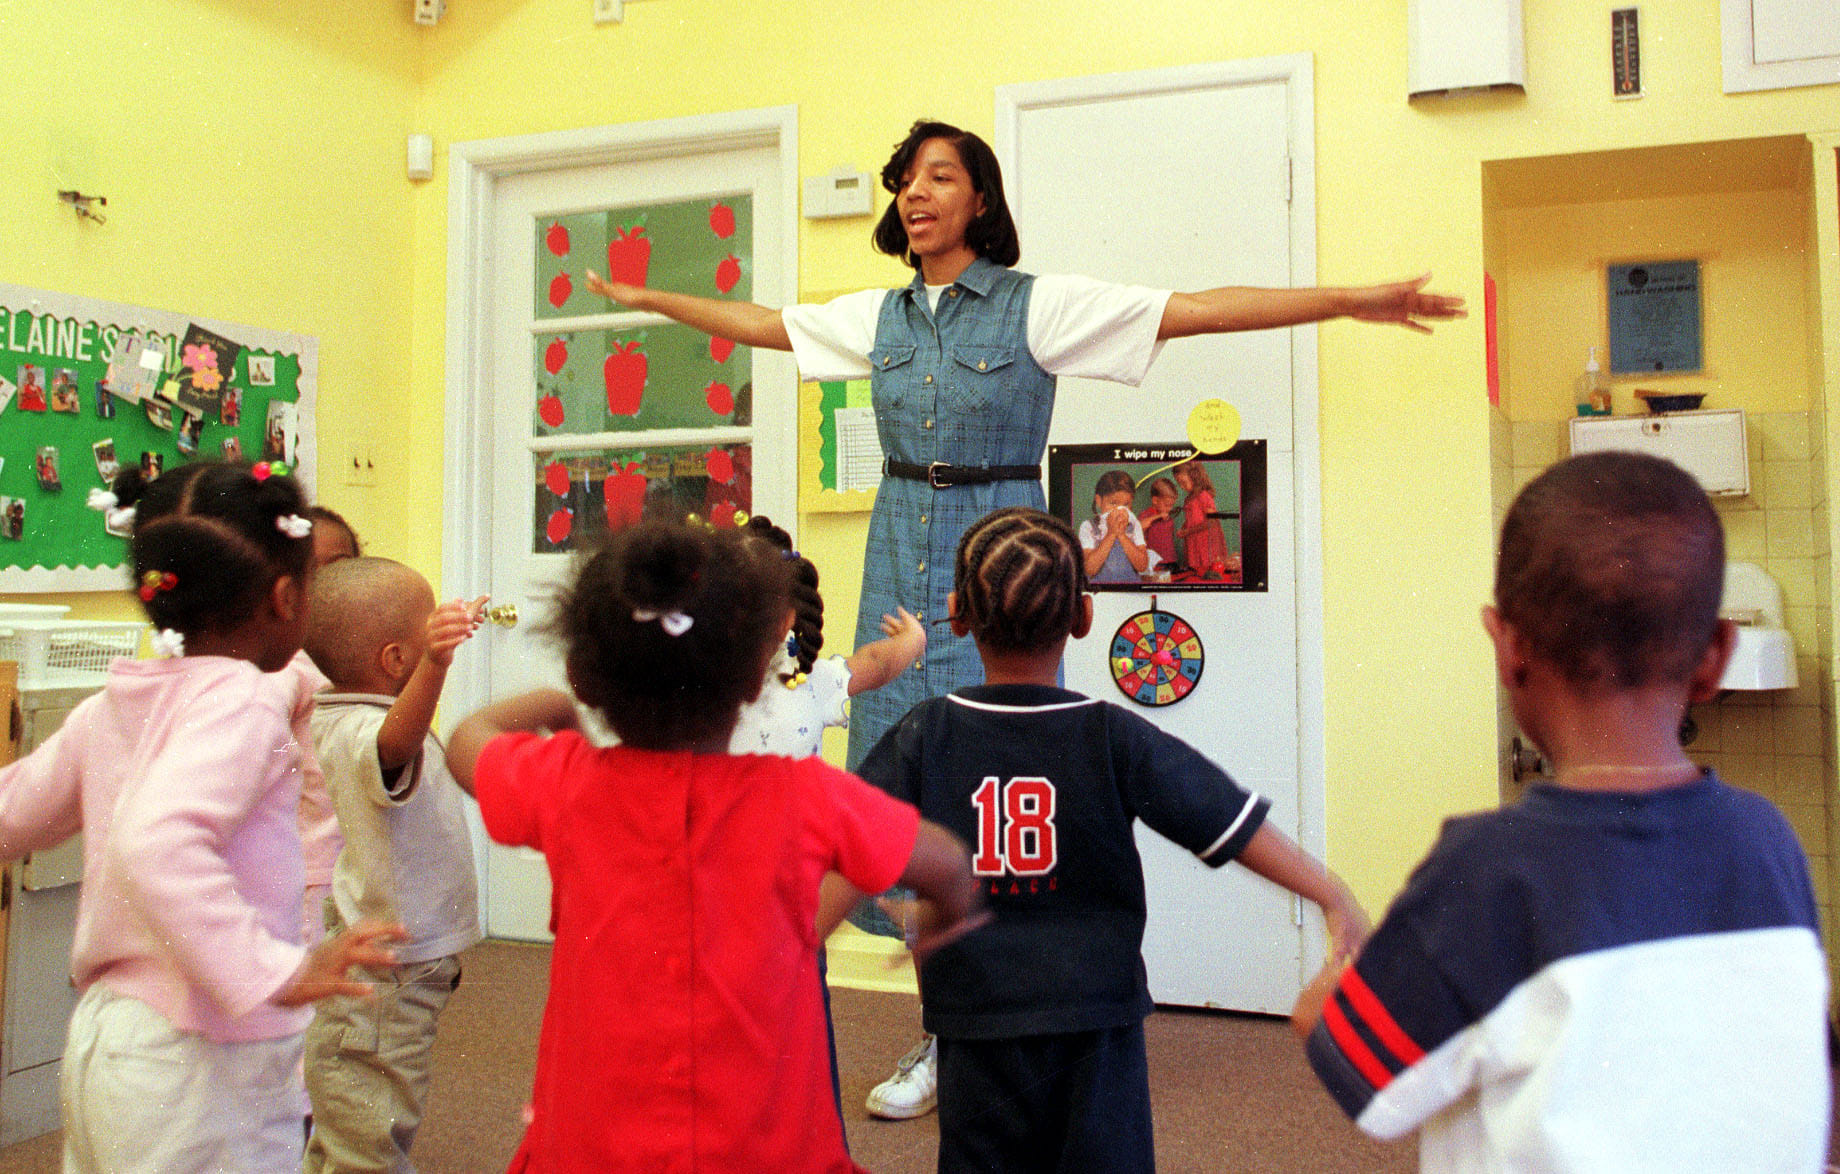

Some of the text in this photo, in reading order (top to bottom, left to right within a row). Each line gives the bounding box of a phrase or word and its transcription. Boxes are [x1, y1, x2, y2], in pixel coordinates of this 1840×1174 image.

[0, 307, 119, 363] LAINE'S
[1114, 448, 1192, 461] I wipe my nose
[971, 776, 1057, 876] 18
